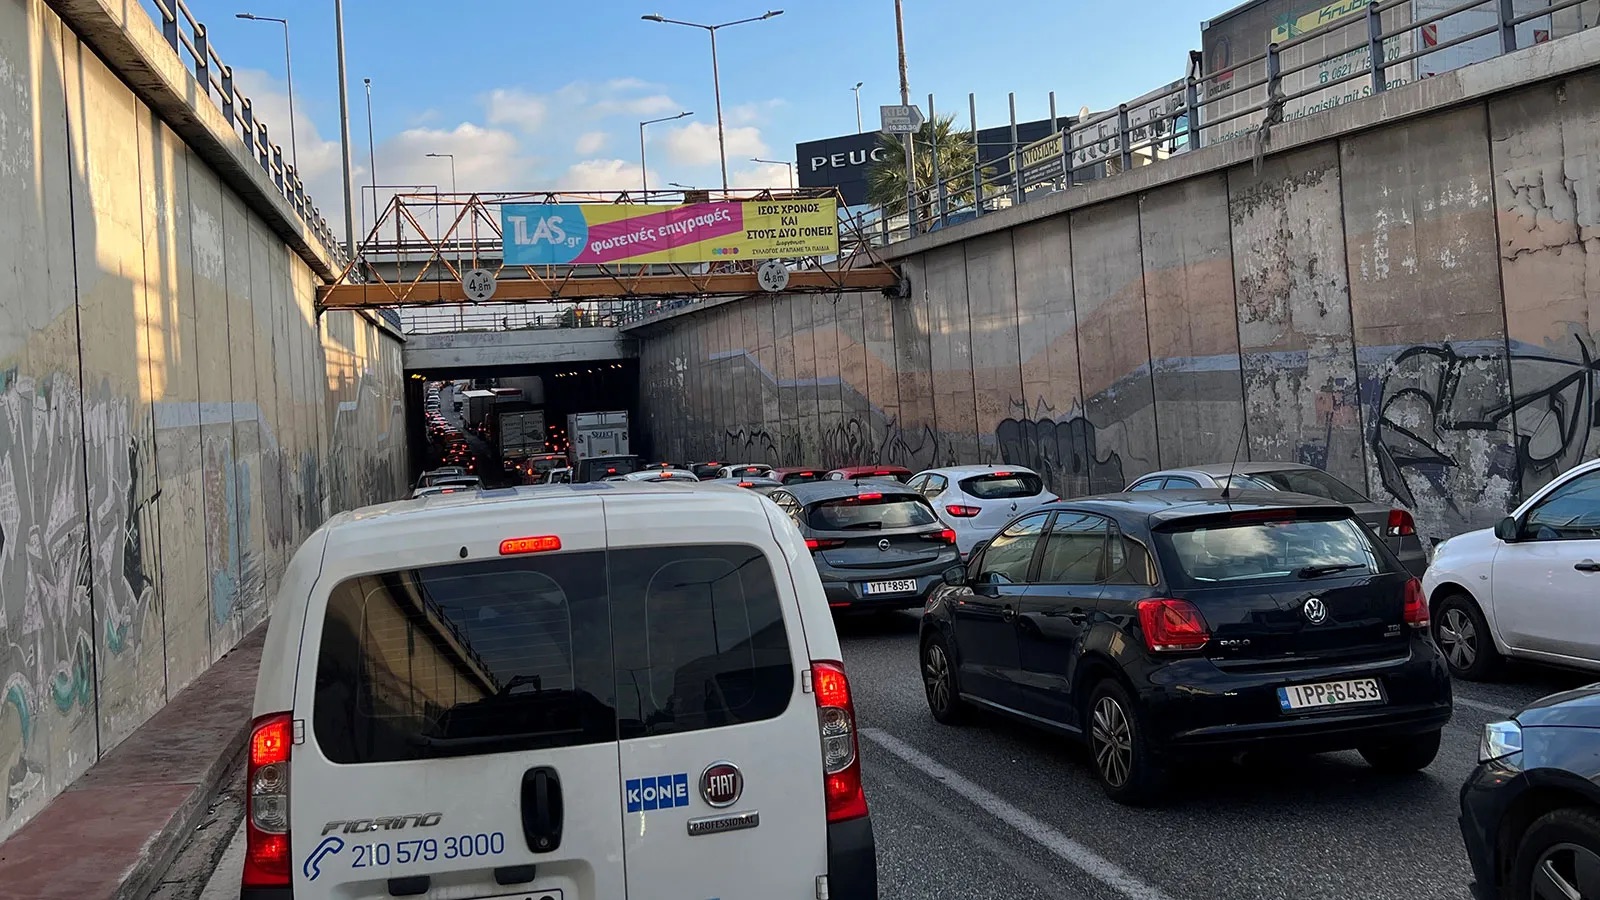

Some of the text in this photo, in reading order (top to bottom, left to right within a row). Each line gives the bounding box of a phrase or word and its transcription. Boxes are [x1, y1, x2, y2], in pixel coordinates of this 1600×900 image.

[1331, 63, 1352, 80] 0621
[758, 203, 819, 215] ΙΣΟΣ ΧΡΟΝΟΣ
[781, 216, 798, 226] ΚΑΙ
[591, 208, 731, 254] φωτεινές επιγραφές
[747, 226, 833, 239] ΣΤΟΥΣ ΔΥΟ ΓΟΝΕΙΣ
[627, 783, 687, 803] KONE
[710, 773, 735, 797] FIAT
[321, 812, 443, 836] FIORINO
[693, 814, 754, 832] PROFESSIONAL
[351, 831, 505, 869] 210 579 3000
